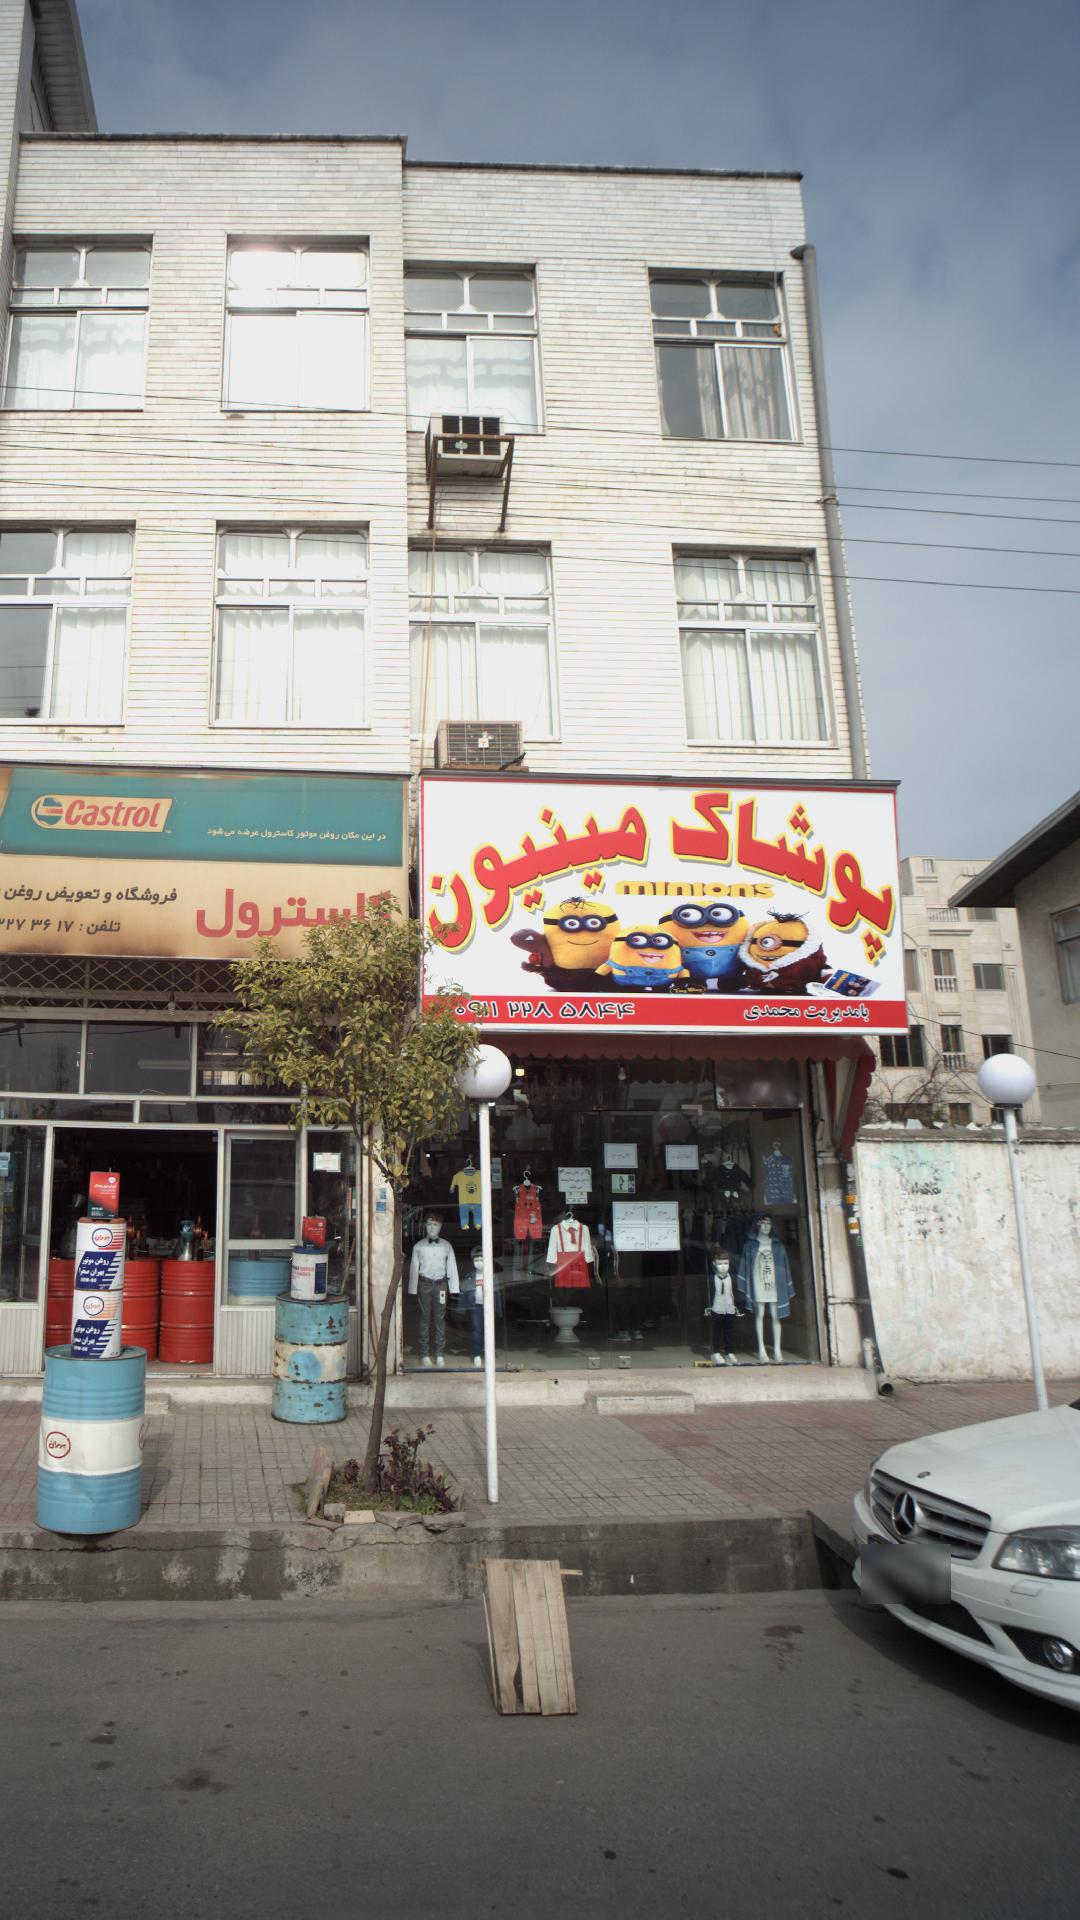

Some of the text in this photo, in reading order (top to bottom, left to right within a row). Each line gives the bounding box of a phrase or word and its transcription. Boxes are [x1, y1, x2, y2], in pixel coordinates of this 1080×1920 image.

[65, 800, 160, 827] Castrol
[237, 828, 259, 837] عرضه
[261, 829, 295, 839] کاسترول
[295, 830, 317, 839] موتور
[319, 830, 340, 840] روغن
[342, 831, 360, 841] مکان
[361, 831, 375, 841] این
[377, 832, 387, 841] در
[428, 789, 897, 963] پوشاک مینیون
[4, 884, 178, 905] فروشگاه و تعویض روغن
[615, 880, 776, 899] minions
[30, 919, 52, 932] ۳۶
[57, 920, 74, 933] ۱۷
[455, 1001, 635, 1019] ۰۹۱۱ ۲۲۸ ۵۸۴۴
[744, 1004, 800, 1021] محمدی
[94, 1257, 110, 1266] روغن
[85, 1326, 100, 1334] روغن
